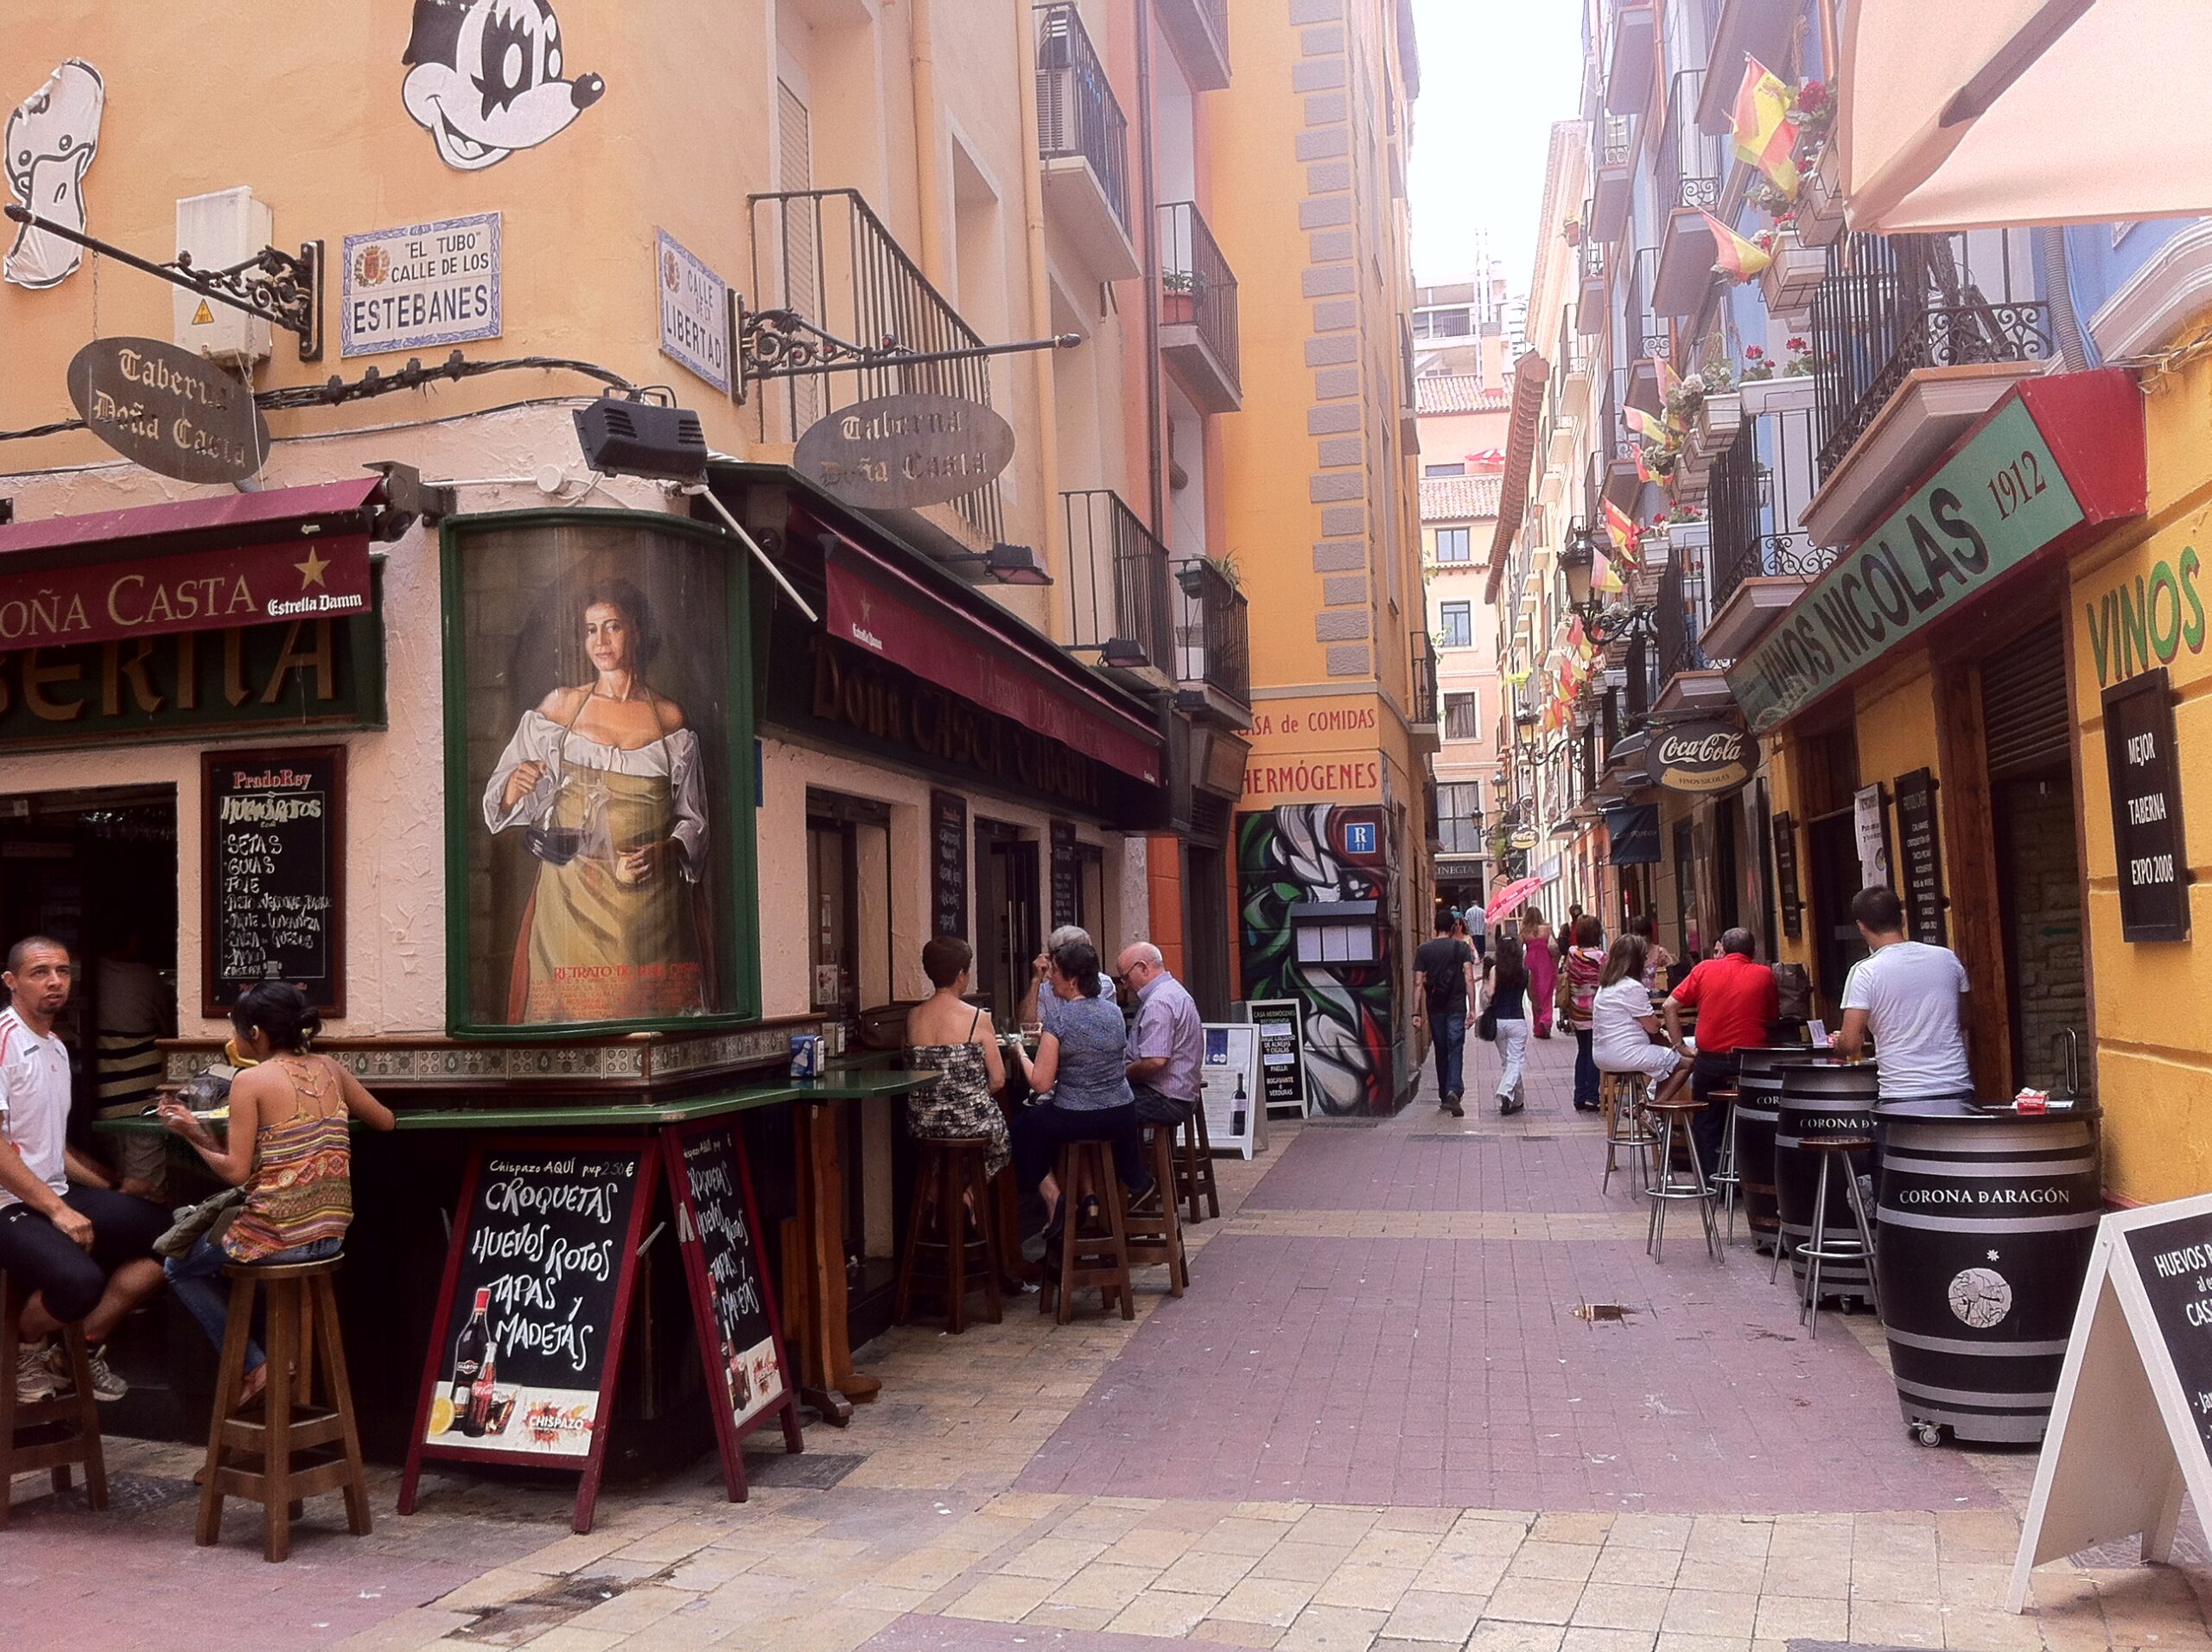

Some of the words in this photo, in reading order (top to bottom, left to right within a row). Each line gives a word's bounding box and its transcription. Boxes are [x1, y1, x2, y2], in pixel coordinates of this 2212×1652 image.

[391, 261, 435, 283] CALLE
[442, 257, 457, 276] DE
[463, 252, 489, 272] LOS
[687, 269, 714, 308] CALLE
[353, 284, 488, 334] ESTEBANES
[665, 300, 721, 369] LIBERTAD
[1753, 614, 1834, 699] VINOS
[1813, 486, 1989, 665] NICOLAS
[1986, 450, 2047, 521] 1912
[267, 596, 317, 617] Estrella
[319, 594, 363, 612] Damm
[2086, 545, 2205, 689] VINOS
[1281, 714, 1299, 734] de
[1308, 708, 1375, 732] COMIDAS
[1659, 733, 1744, 765] Coca-Cola
[2127, 732, 2156, 766] MEJOR
[233, 769, 312, 791] PradoRey
[1243, 759, 1377, 795] HERMÓGENES
[2127, 792, 2166, 825] TABERNA
[227, 833, 283, 856] SETAS
[1354, 827, 1367, 843] R
[226, 875, 260, 894] FOIE
[2131, 855, 2153, 886] EXPO
[2152, 854, 2174, 884] 2008
[554, 964, 613, 980] RETRATO
[1800, 1118, 1858, 1129] CORONA
[490, 1160, 541, 1176] Chispazo
[543, 1157, 576, 1174] AQUÍ
[486, 1177, 618, 1223] CROQUETAS
[1899, 1189, 1974, 1204] CORONA
[696, 1198, 725, 1244] HUEVOS
[472, 1223, 550, 1264] HUEVOS
[544, 1237, 613, 1282] ROTOS
[710, 1247, 739, 1284] TAPAS
[2153, 1245, 2207, 1279] HUEVOS
[488, 1274, 556, 1314] TAPAS
[721, 1275, 760, 1331] MADEJAS
[2186, 1298, 2212, 1328] CAS
[495, 1312, 594, 1372] MADEJAS
[529, 1415, 584, 1431] CHISPAZO
